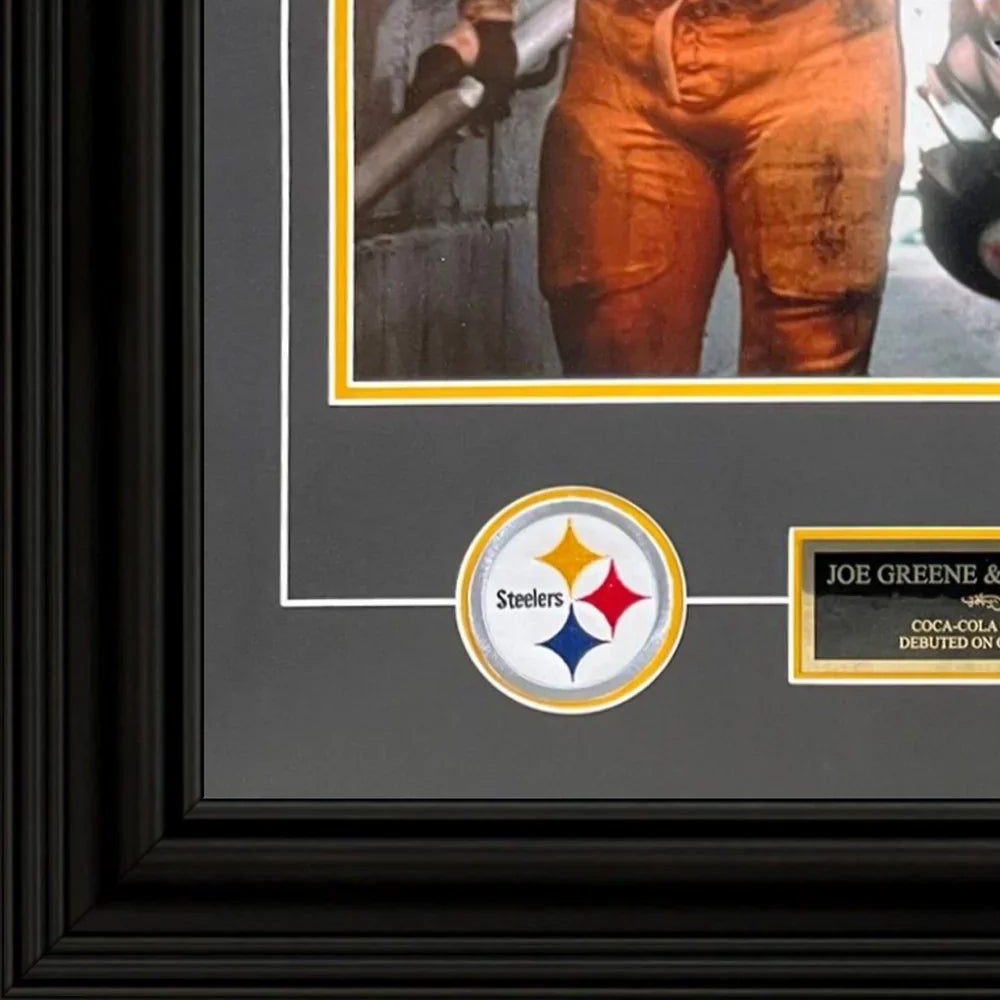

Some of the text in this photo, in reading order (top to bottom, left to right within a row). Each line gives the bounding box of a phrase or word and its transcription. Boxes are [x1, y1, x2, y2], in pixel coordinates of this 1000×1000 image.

[826, 563, 872, 585] JOE
[876, 563, 978, 585] GREENE
[496, 588, 564, 609] Steelers
[911, 619, 998, 633] COCA-COLA
[899, 636, 969, 650] DEBUTED
[971, 636, 993, 650] ON
